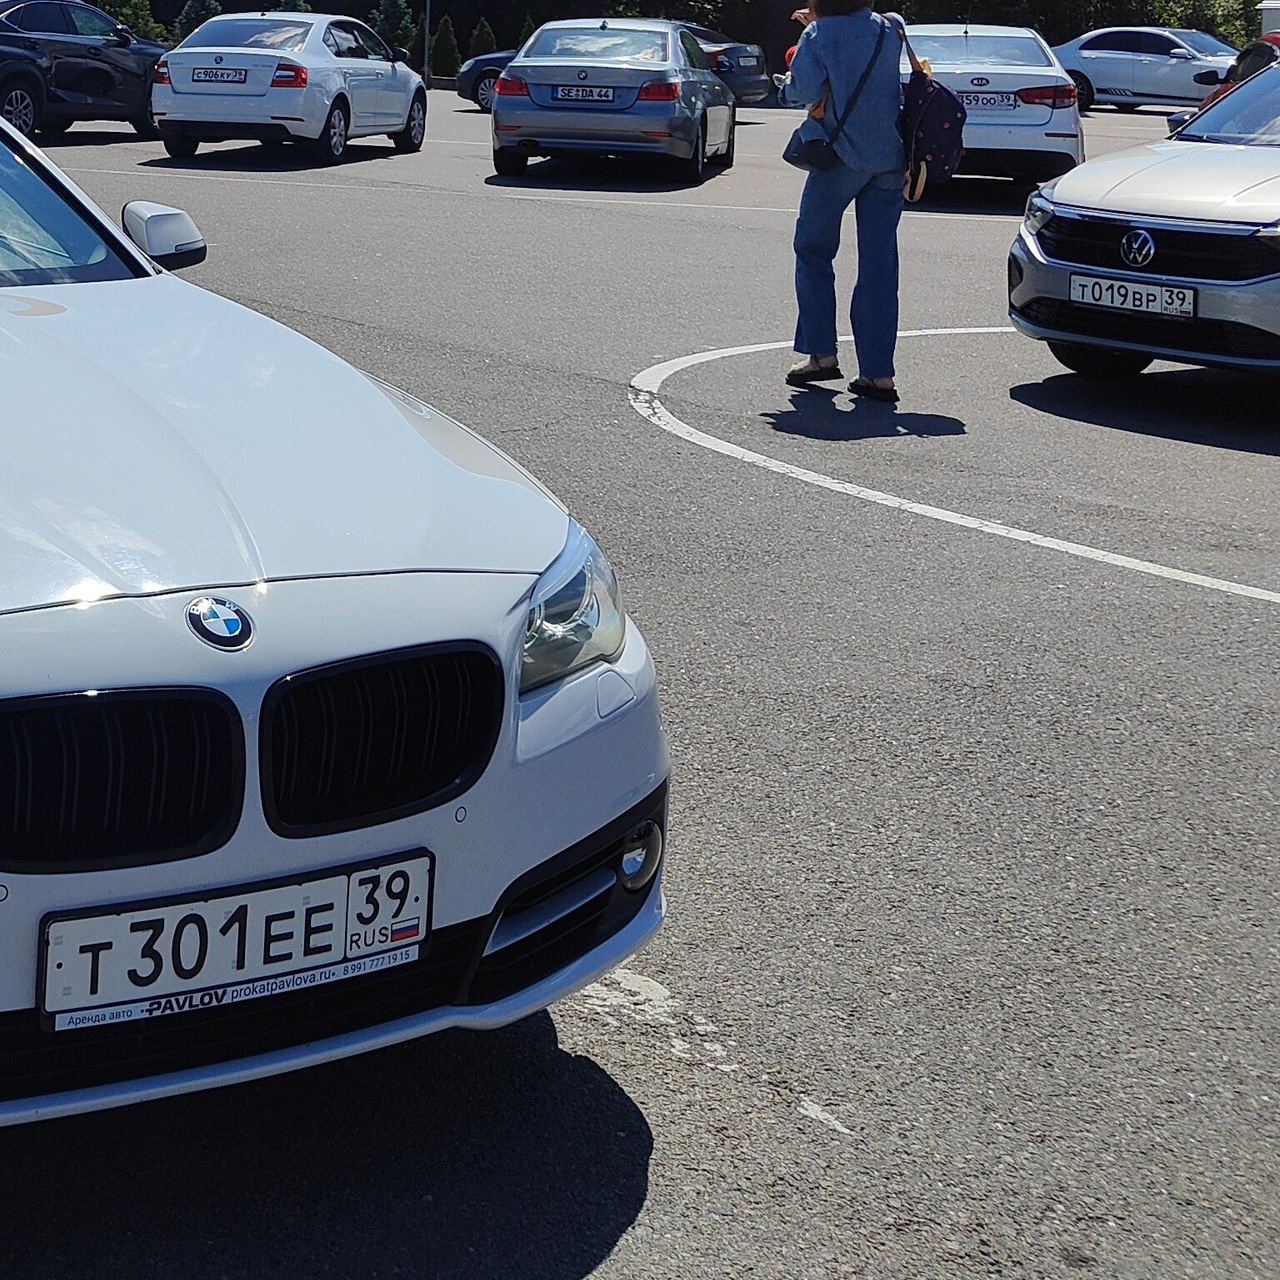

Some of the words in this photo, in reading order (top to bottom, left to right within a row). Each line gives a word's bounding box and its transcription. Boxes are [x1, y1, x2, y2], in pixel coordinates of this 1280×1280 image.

[560, 88, 576, 98] SE
[581, 89, 594, 99] DA
[597, 90, 609, 99] 44
[972, 78, 988, 86] KIA
[1165, 289, 1186, 307] 39
[79, 902, 335, 995] Т301ЕЕ
[355, 870, 411, 926] 39
[349, 926, 389, 951] RUS
[343, 966, 349, 976] 8
[350, 963, 366, 974] 991
[369, 957, 385, 968] 777
[387, 953, 398, 964] 19
[400, 950, 410, 961] 15
[231, 970, 332, 1002] prokatpavlova.ru
[145, 989, 228, 1016] PAVLOV
[67, 1013, 107, 1026] Аренда
[109, 1010, 133, 1020] авто
